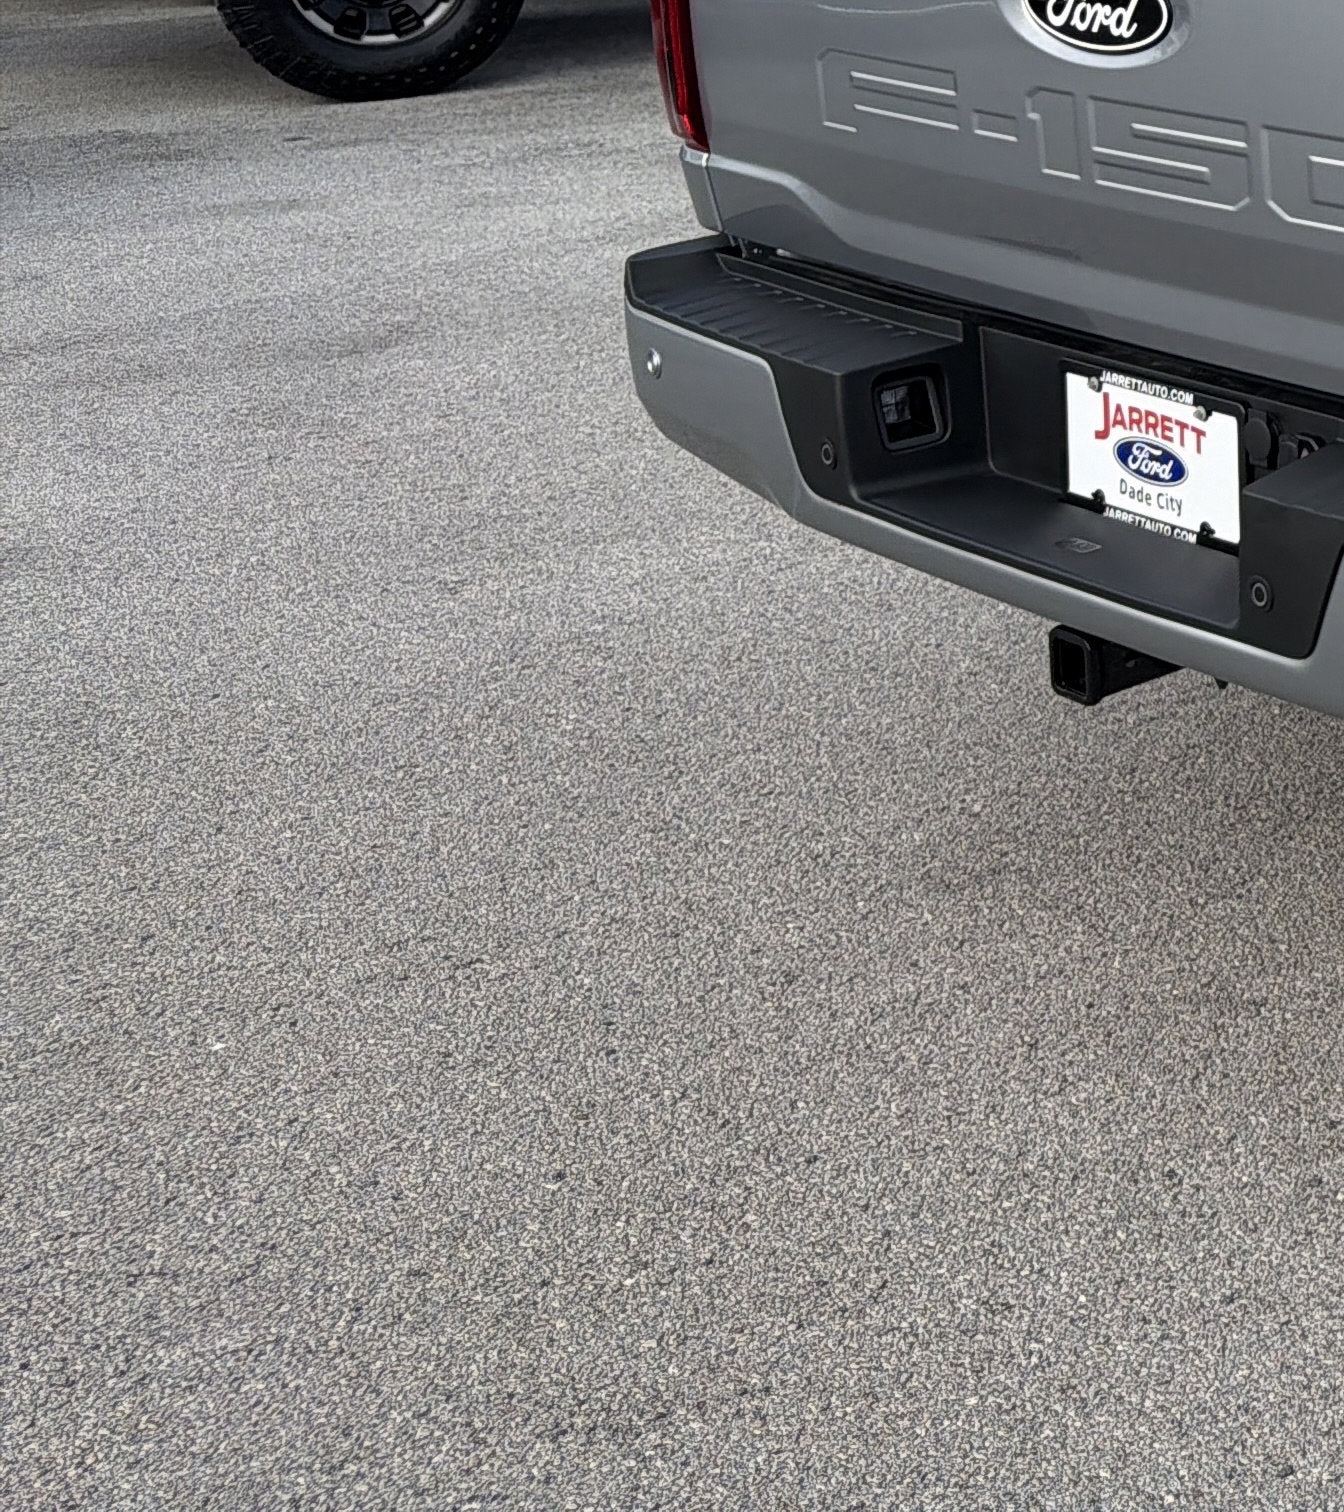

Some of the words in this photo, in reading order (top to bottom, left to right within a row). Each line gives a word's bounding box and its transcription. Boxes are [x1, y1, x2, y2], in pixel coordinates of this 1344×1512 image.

[1100, 370, 1194, 406] JARRETTAUTO.COM
[1094, 391, 1207, 456] JARRETT
[1127, 441, 1174, 481] Ford
[1119, 477, 1153, 507] Dade
[1156, 492, 1183, 517] City
[1102, 506, 1197, 544] JARRETTAUTOCOM
